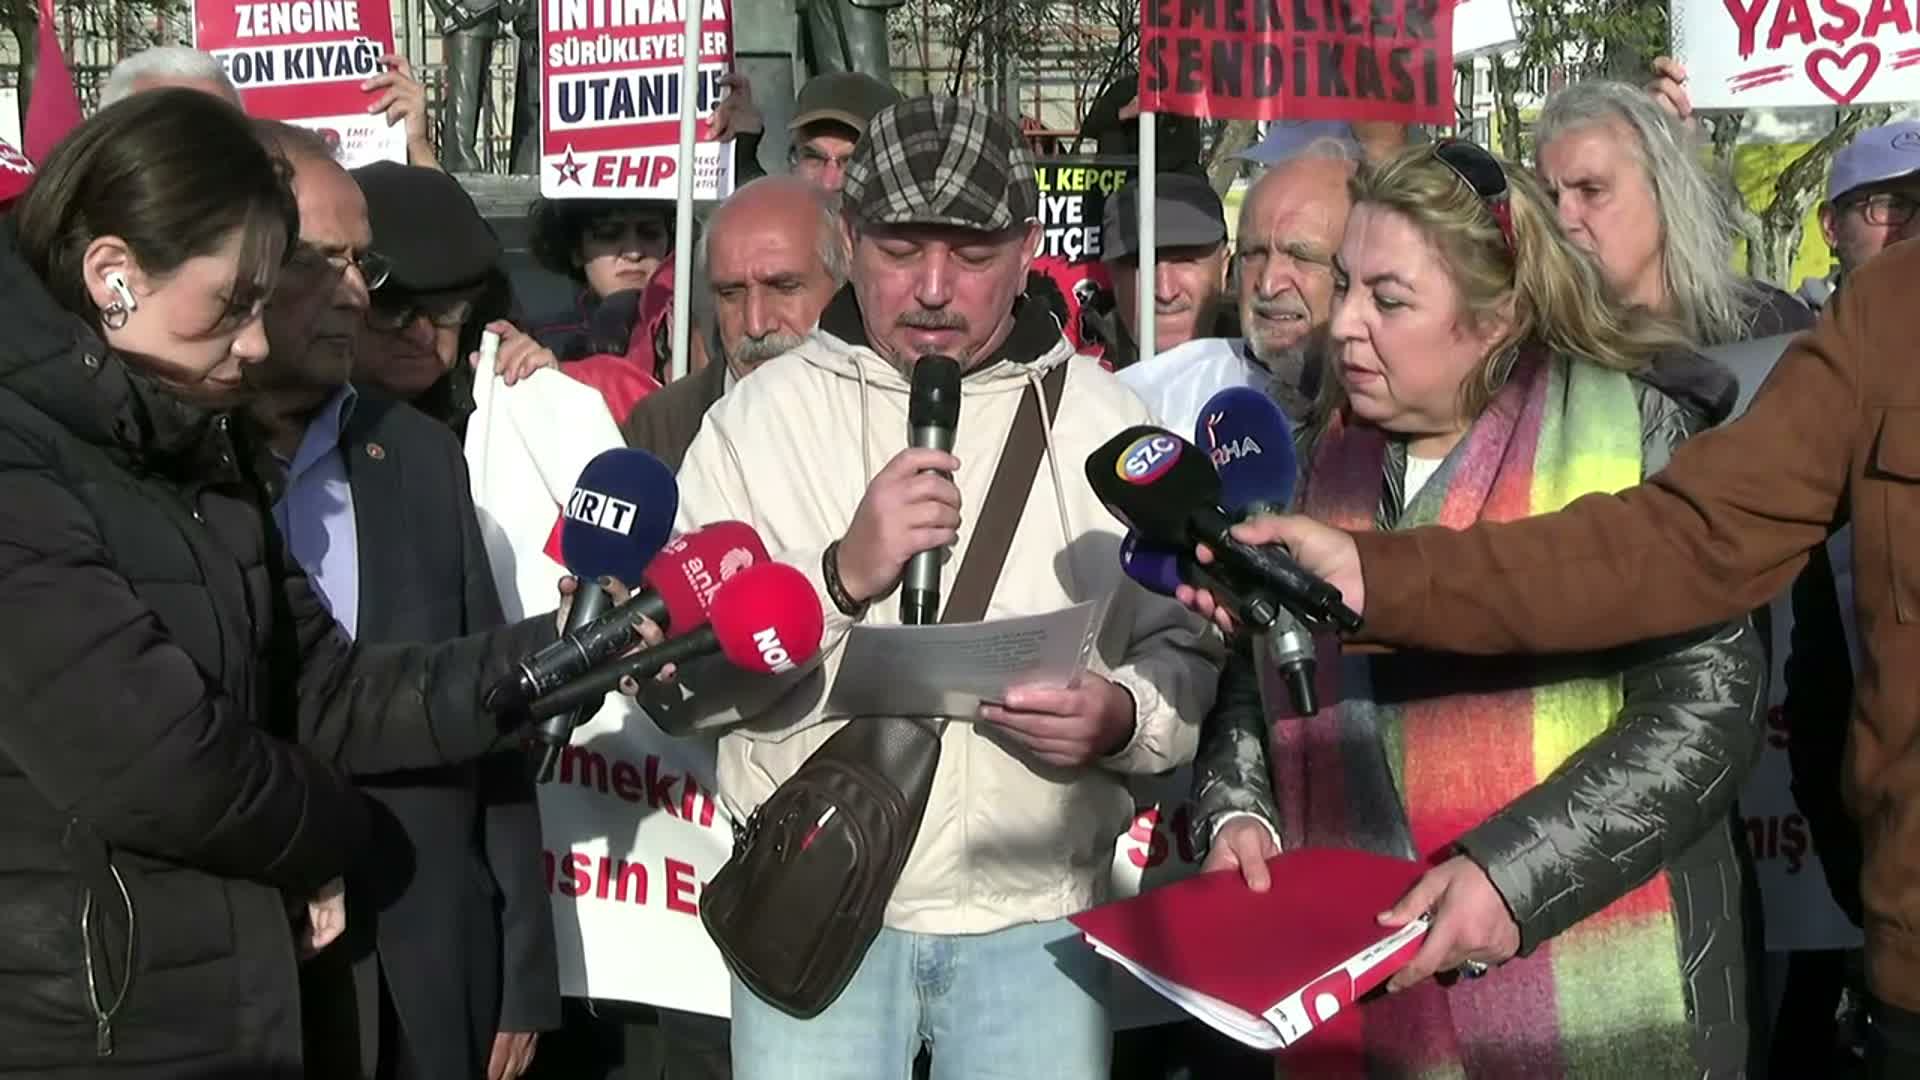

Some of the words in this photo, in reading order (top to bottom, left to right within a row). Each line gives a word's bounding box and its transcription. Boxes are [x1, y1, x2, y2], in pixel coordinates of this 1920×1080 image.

[549, 32, 728, 67] SÜRÜKLEYEER
[1723, 0, 1920, 61] YAŞA
[1146, 35, 1439, 106] SENDİKASI
[592, 156, 677, 188] EHP
[1126, 435, 1175, 477] SZC
